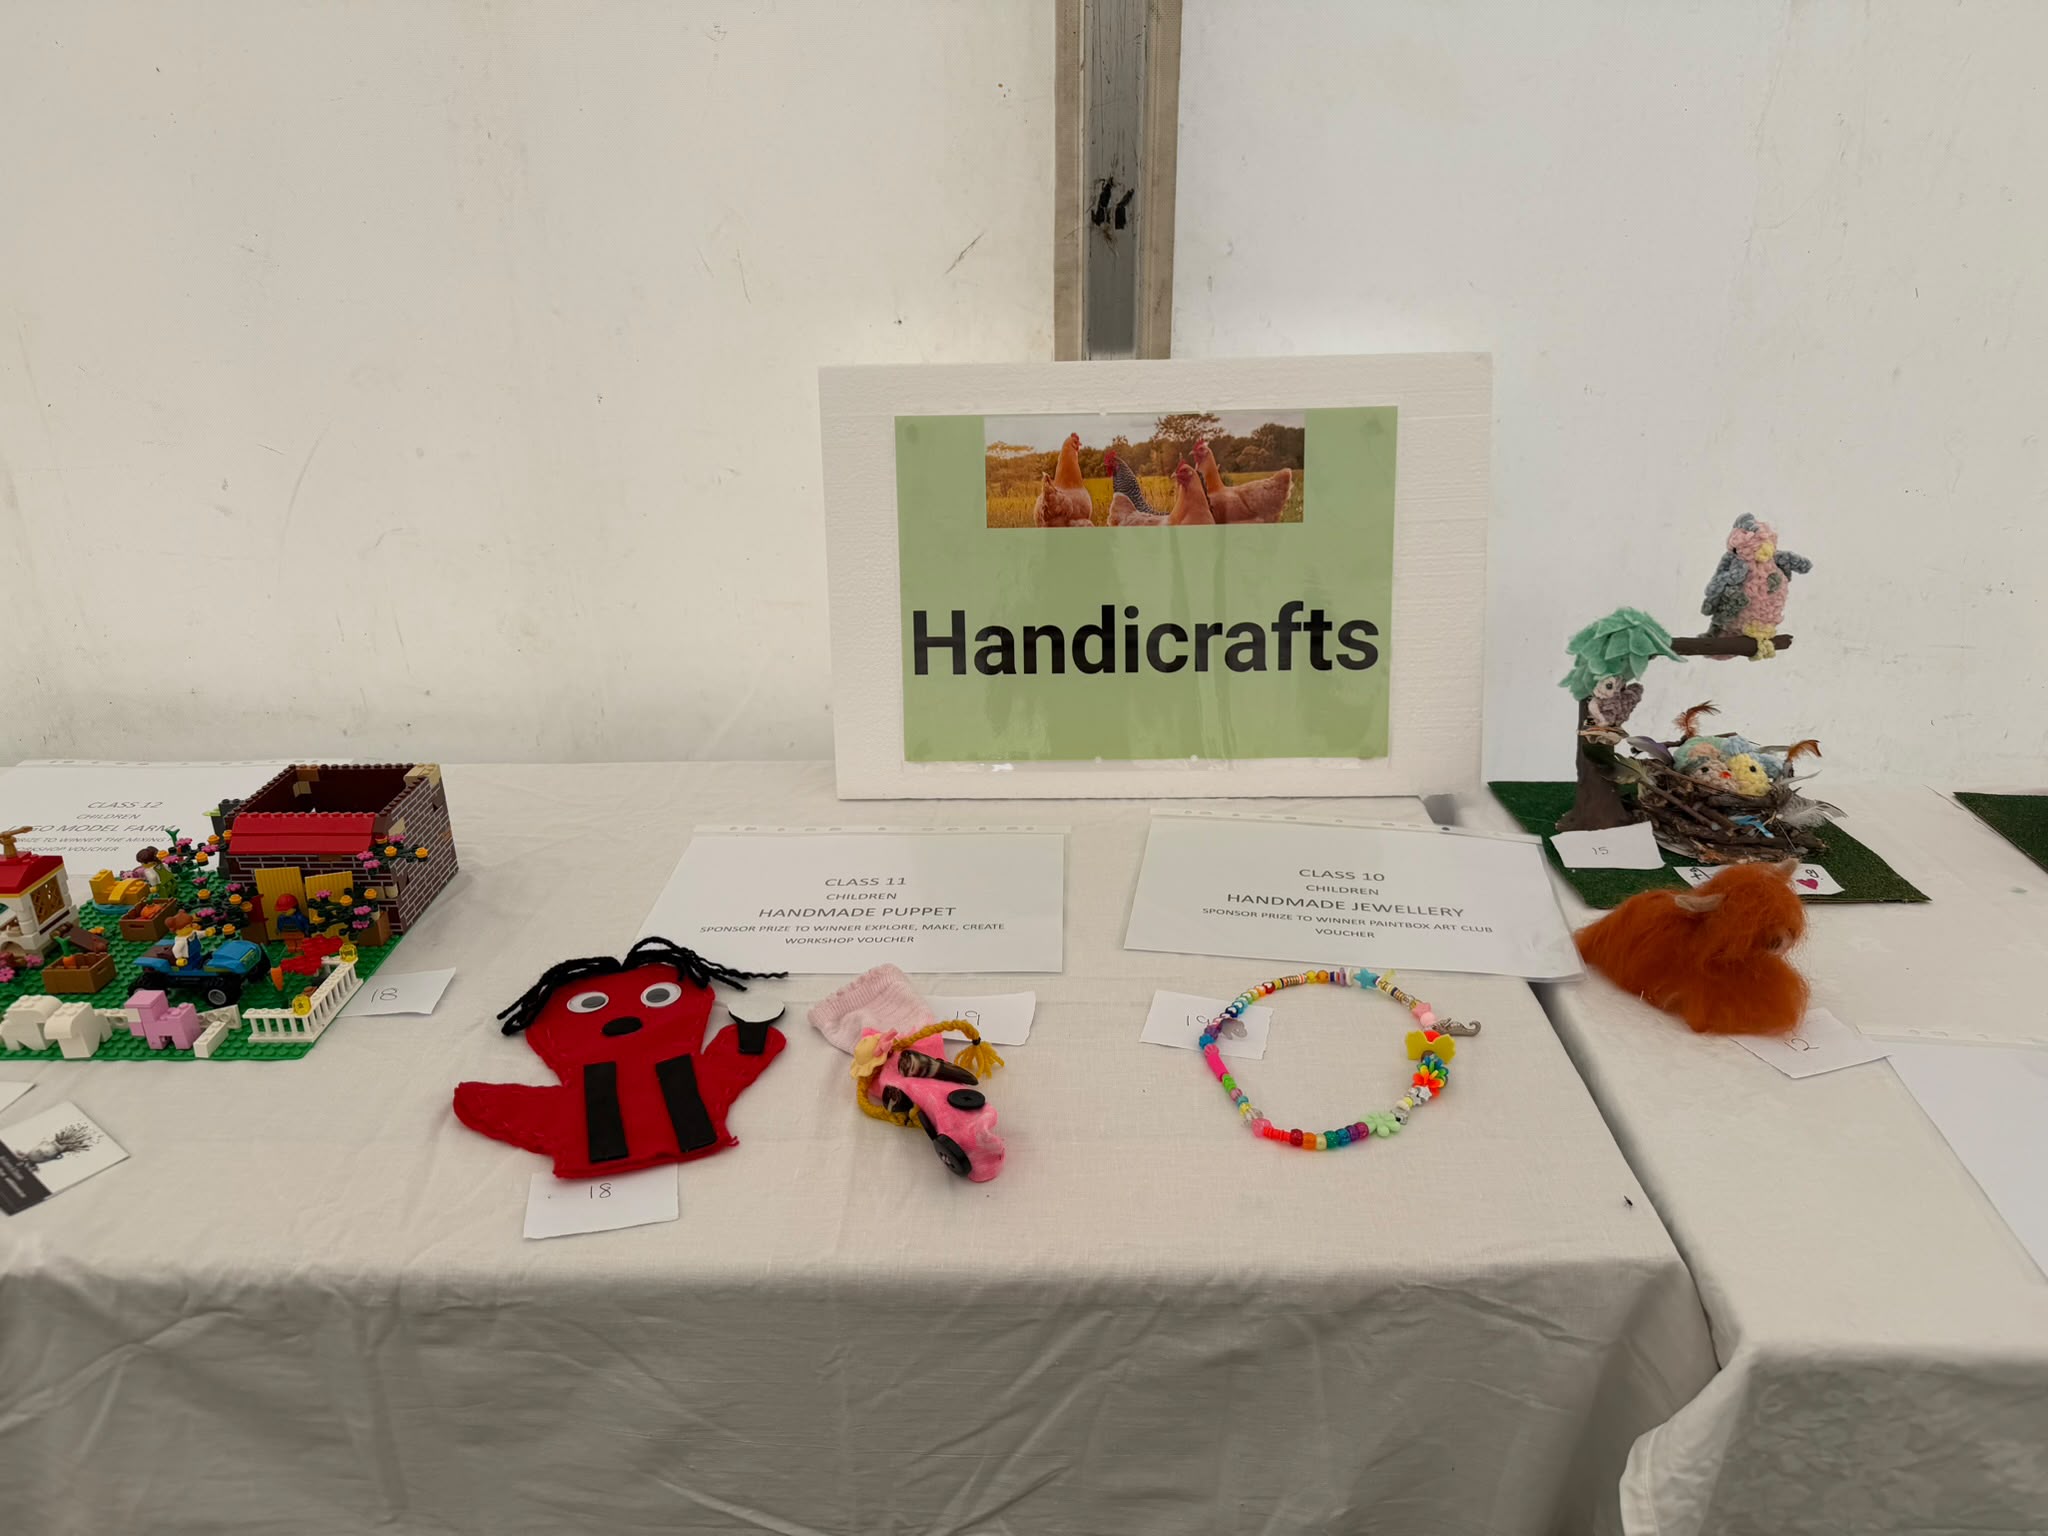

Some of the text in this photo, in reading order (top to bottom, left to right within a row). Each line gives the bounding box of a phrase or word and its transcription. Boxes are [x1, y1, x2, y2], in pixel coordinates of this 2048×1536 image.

[912, 600, 1380, 676] Handicrafts
[87, 801, 140, 809] CLASS
[1299, 869, 1385, 882] CLASS 10
[824, 877, 908, 887] CLASS 11
[1305, 884, 1379, 896] CHILDREN
[826, 892, 897, 901] CHILDREN
[1227, 893, 1464, 918] HANDMADE JEWELLERY
[758, 907, 957, 918] HANDMADE PUPPET
[1202, 908, 1493, 933] SPONSOR PRIZE TO WINNER PAINTBOX ART CLUB
[699, 925, 756, 933] SPONSOR
[864, 924, 918, 932] EXPLORE,
[922, 923, 959, 931] MAKE,
[1315, 928, 1375, 938] VOUCHER
[370, 987, 398, 1003] 18
[1783, 1037, 1820, 1051] 12
[590, 1182, 612, 1199] 18
